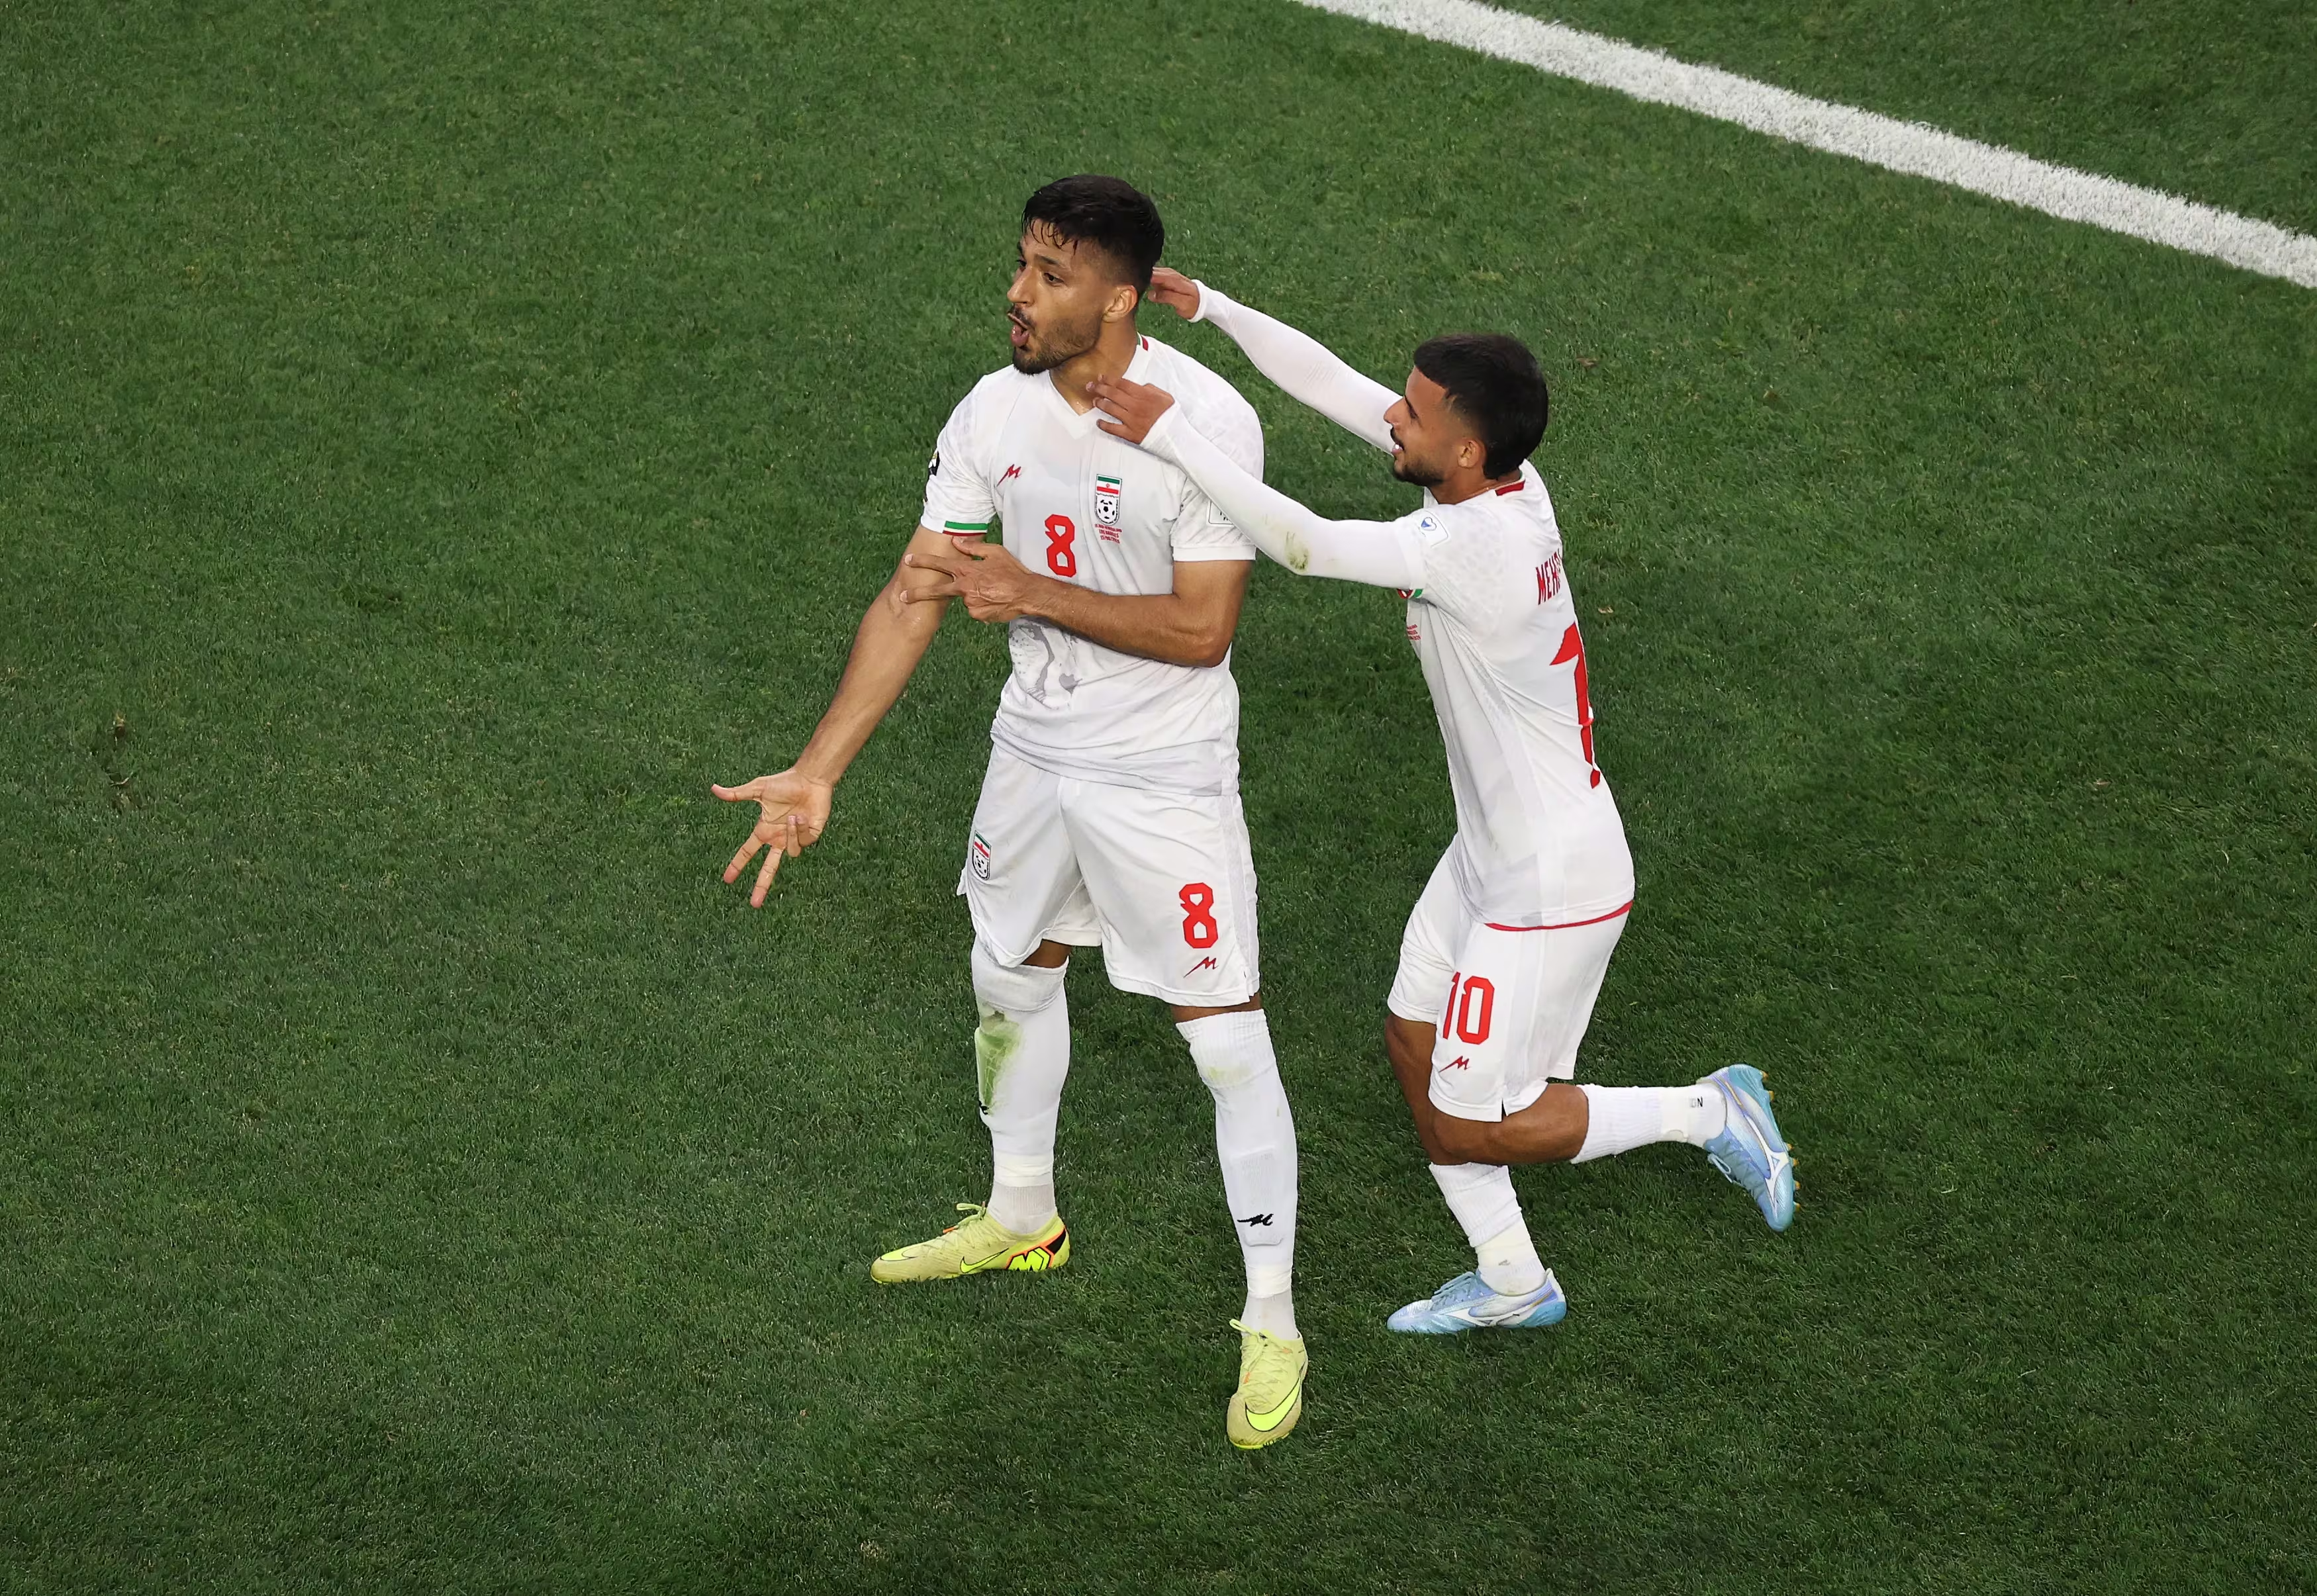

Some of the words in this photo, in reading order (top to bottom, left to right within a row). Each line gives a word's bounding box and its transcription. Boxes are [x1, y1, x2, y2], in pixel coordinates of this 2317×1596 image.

[1045, 514, 1076, 578] 8
[1535, 548, 1561, 605] MEH
[1178, 882, 1219, 949] 8
[1442, 971, 1495, 1045] 10
